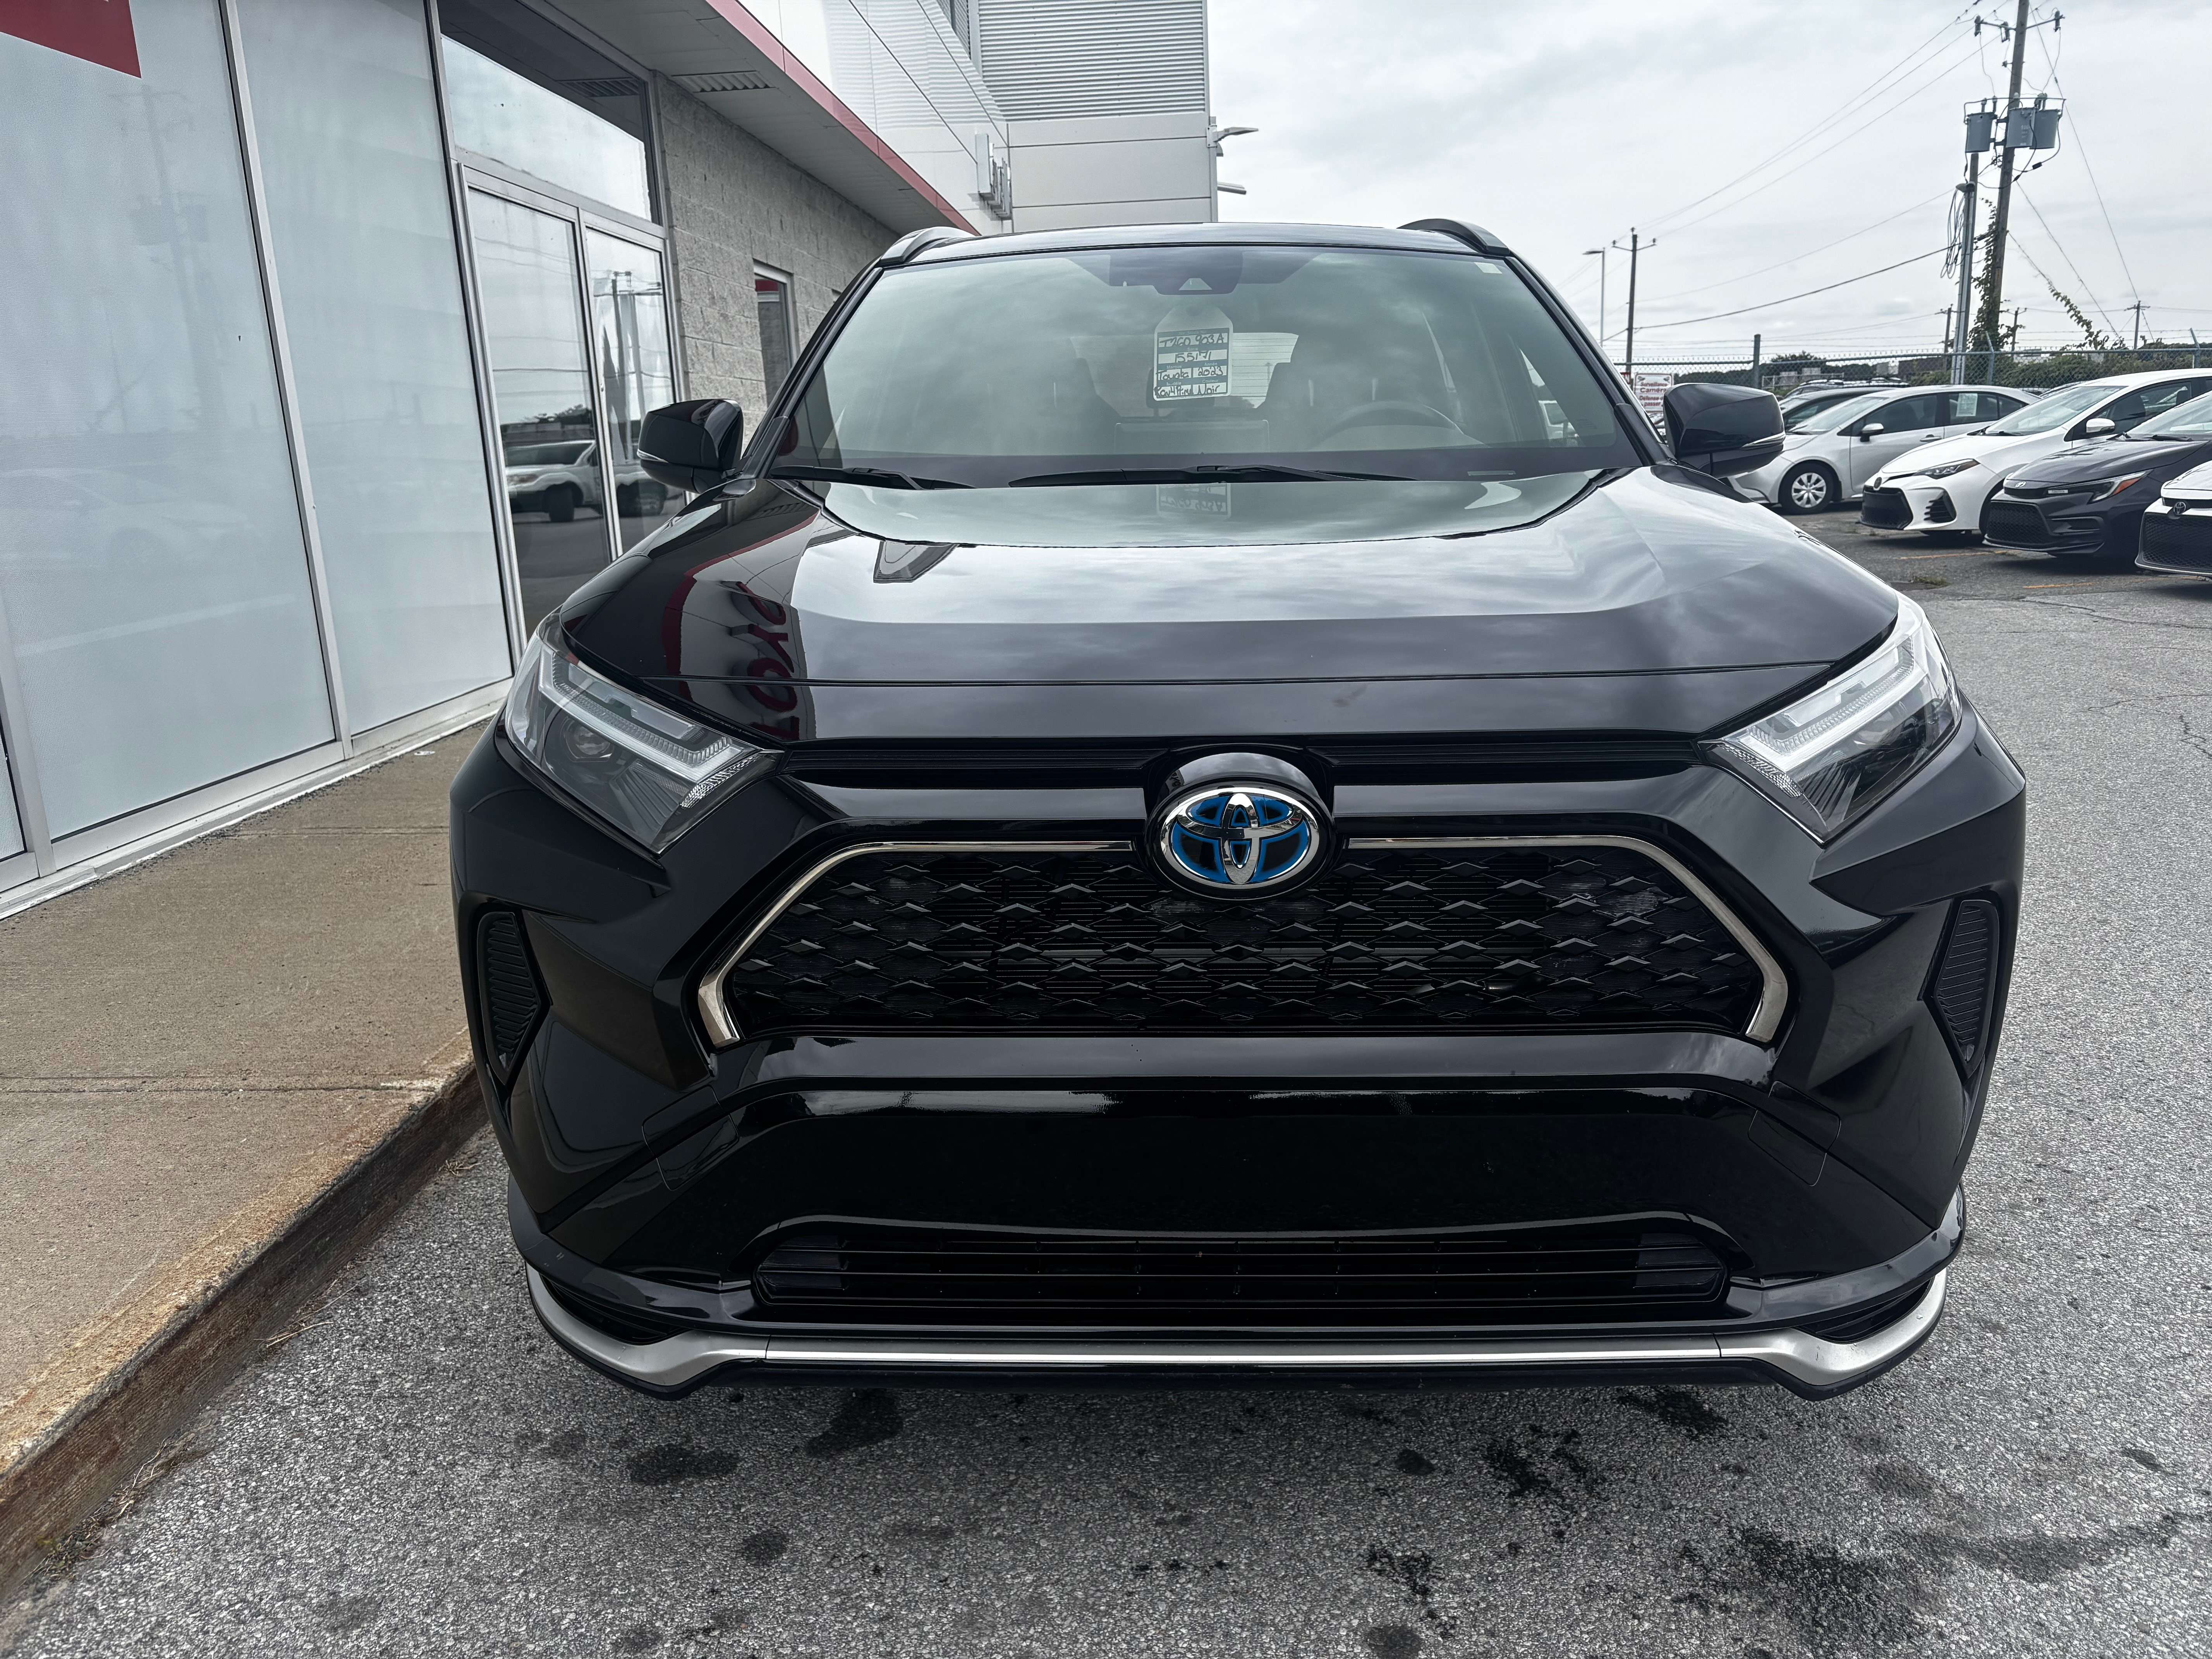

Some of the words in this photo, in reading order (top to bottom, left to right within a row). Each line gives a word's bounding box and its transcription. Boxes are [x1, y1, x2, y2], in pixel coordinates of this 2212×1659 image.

[1156, 369, 1189, 381] Toyota
[1198, 366, 1223, 376] 2023
[1193, 383, 1220, 395] Noir
